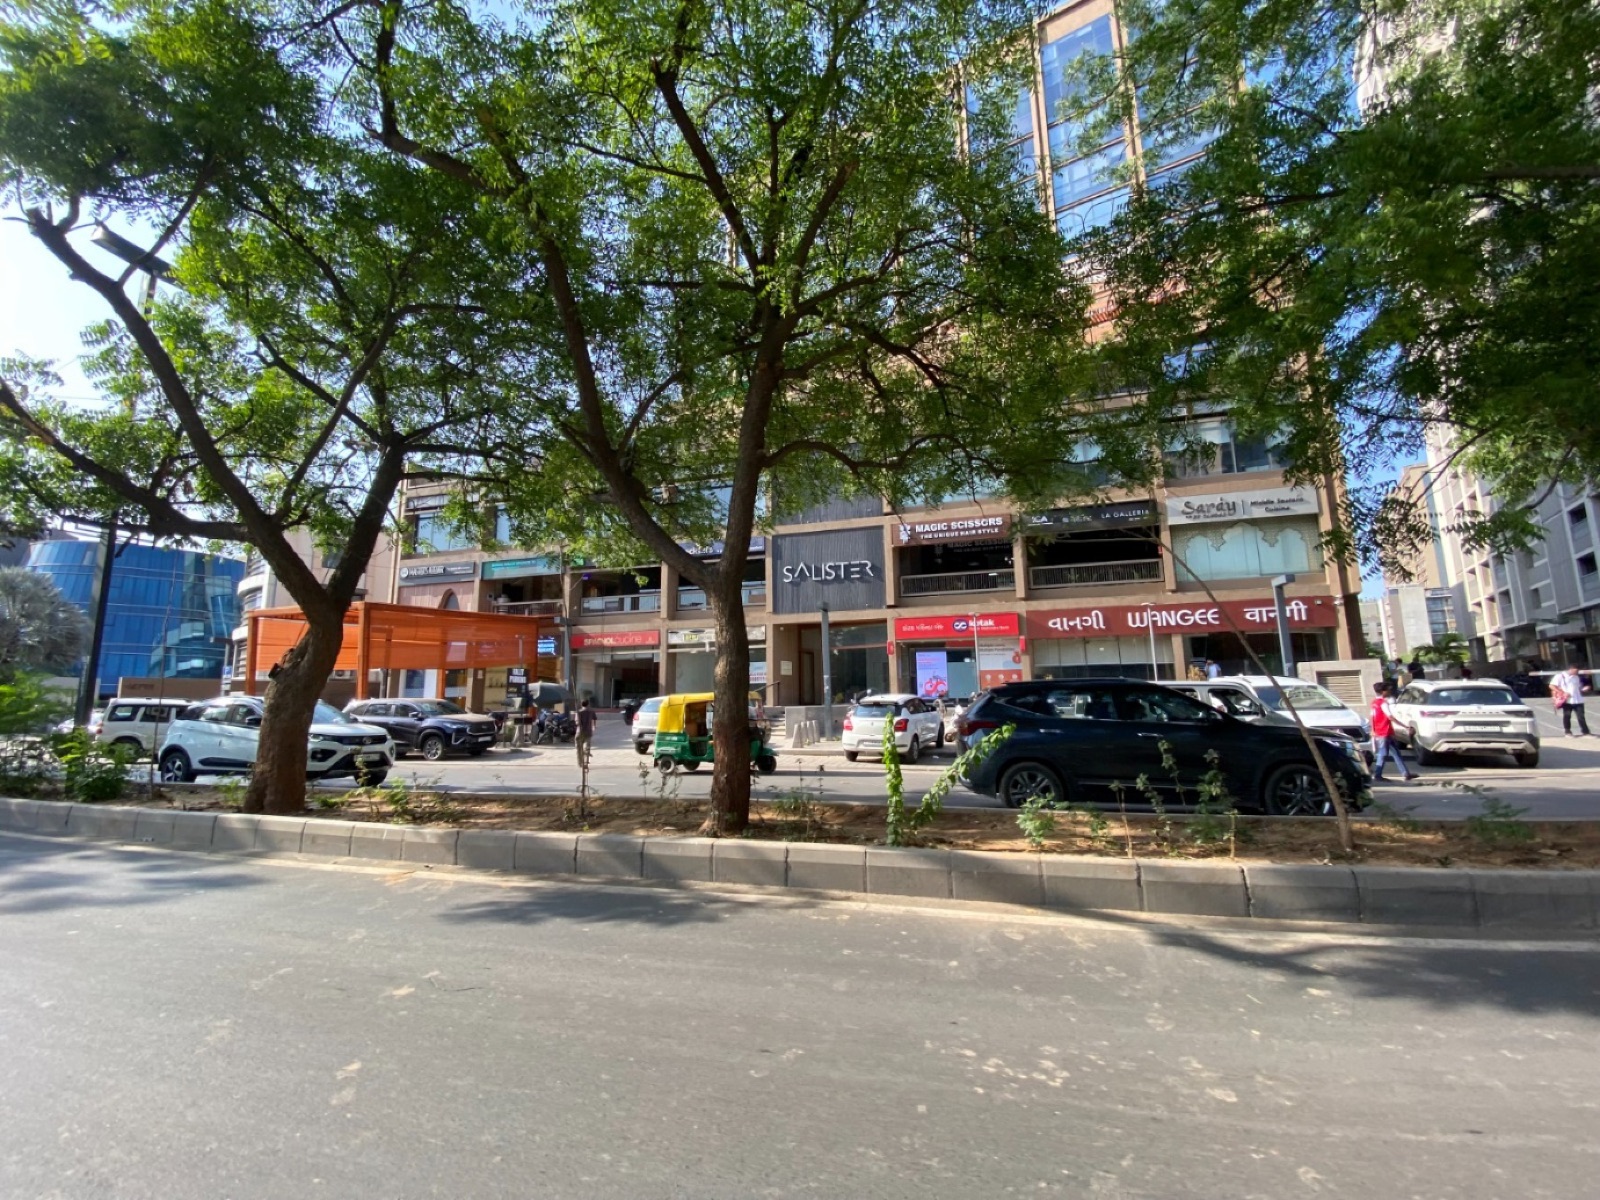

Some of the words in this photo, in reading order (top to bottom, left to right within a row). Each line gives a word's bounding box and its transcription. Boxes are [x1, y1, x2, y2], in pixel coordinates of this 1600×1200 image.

[915, 523, 948, 533] MAGIC
[951, 517, 1003, 530] SCISSORS
[783, 560, 874, 582] SALISTER
[1048, 610, 1106, 631] વાનગી
[1127, 608, 1220, 628] WANGEE
